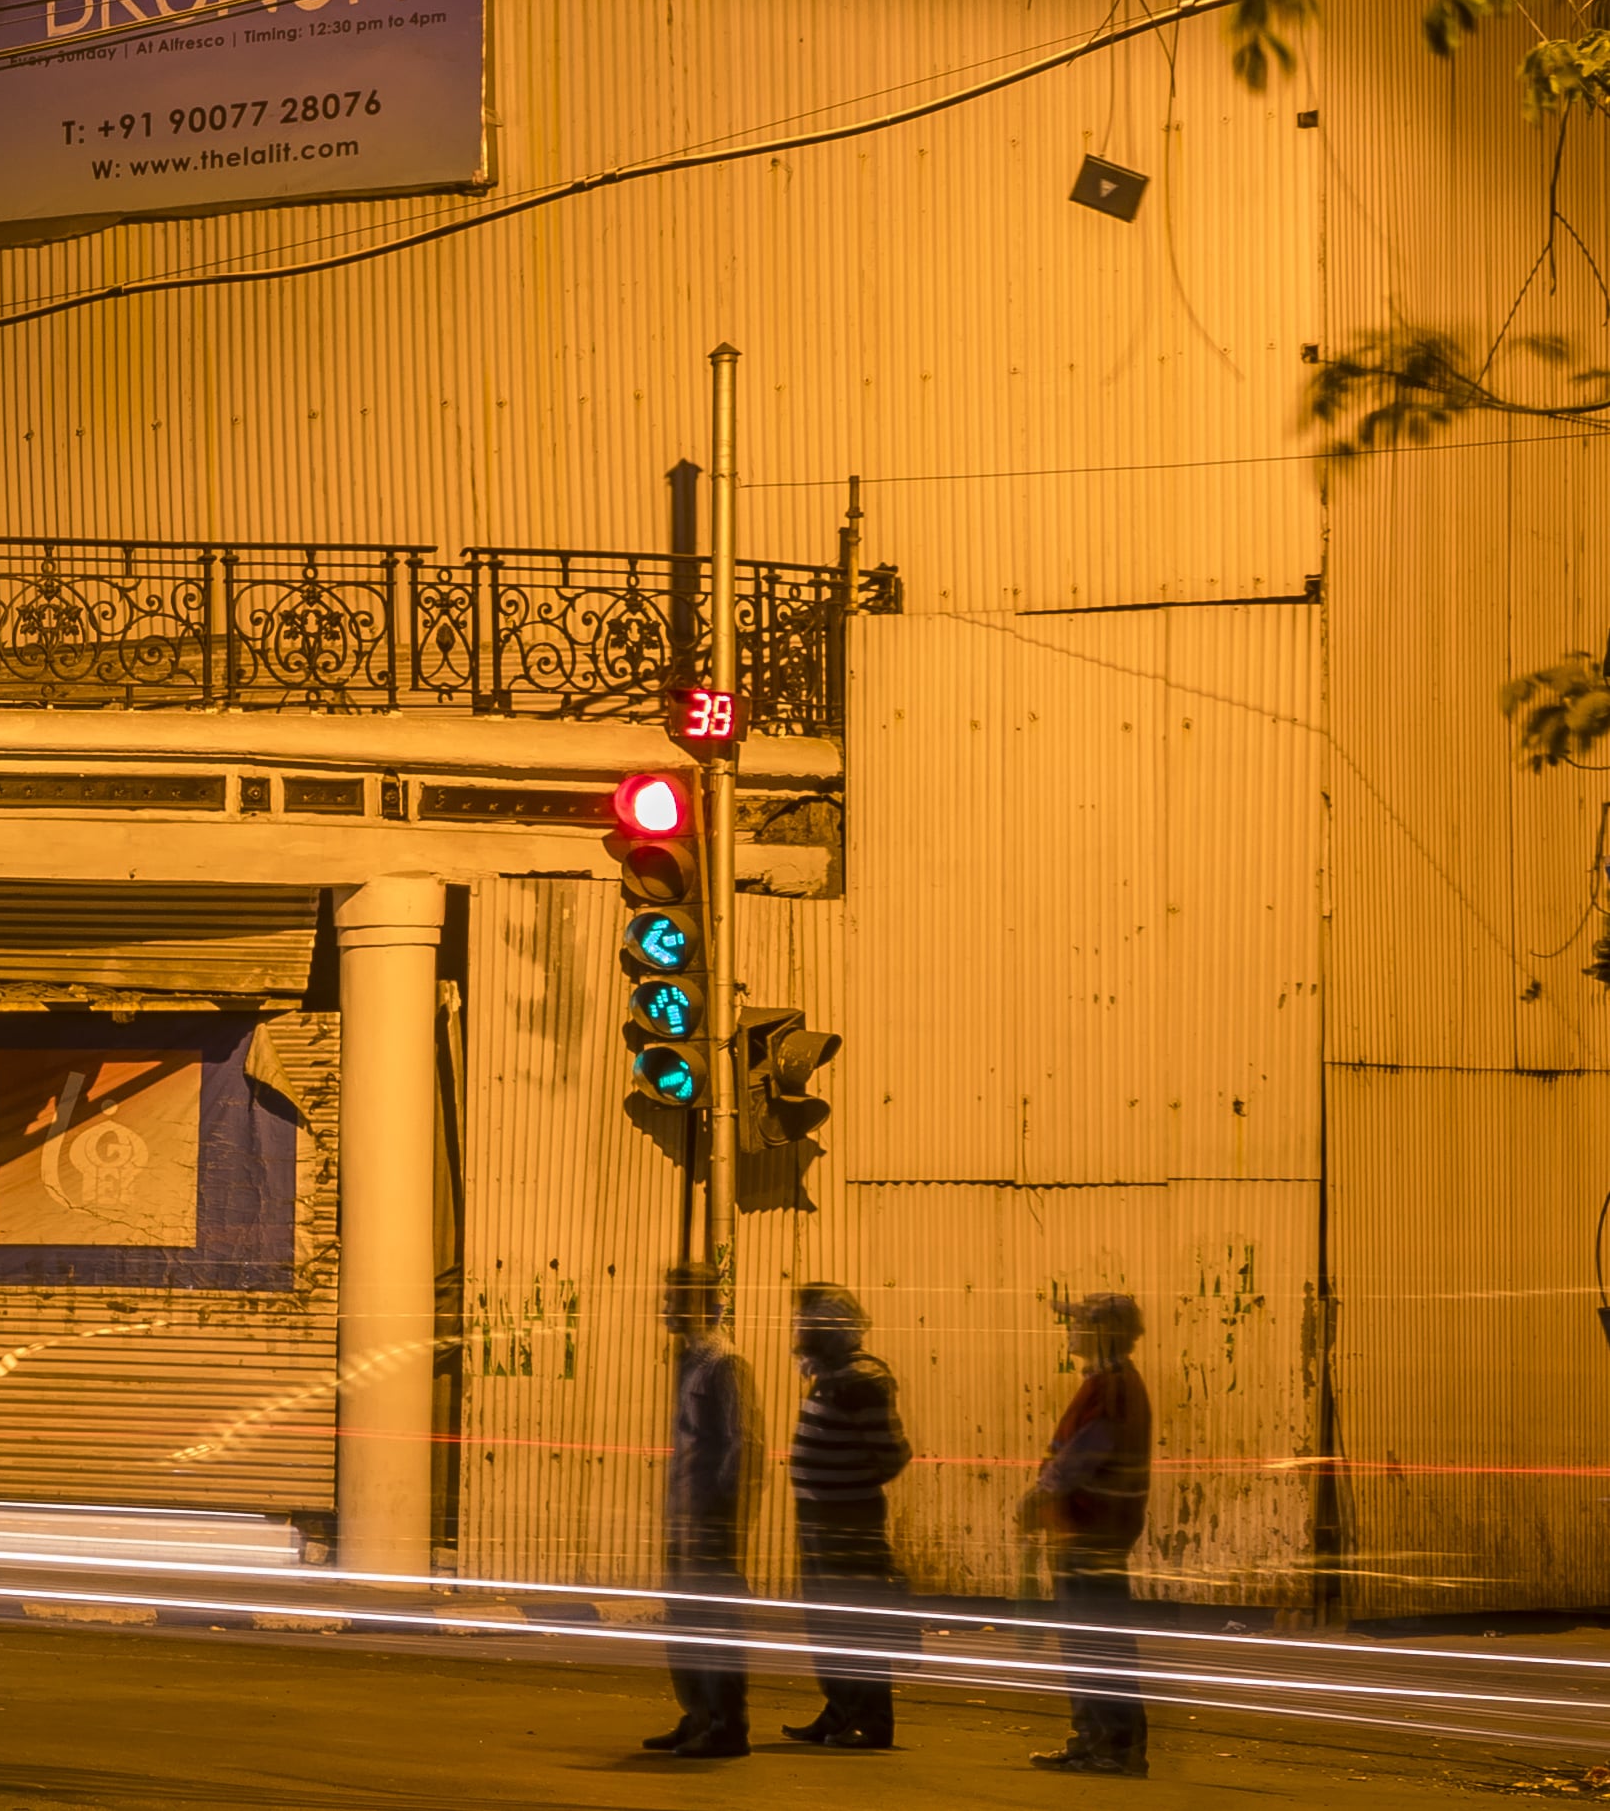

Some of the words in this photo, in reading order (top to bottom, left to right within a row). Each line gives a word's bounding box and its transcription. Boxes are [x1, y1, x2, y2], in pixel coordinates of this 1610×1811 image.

[135, 39, 158, 56] At
[160, 33, 225, 52] Alfresco
[243, 24, 303, 45] Timing:
[308, 20, 352, 38] 12:30
[356, 19, 384, 36] pm
[389, 13, 405, 29] to
[409, 11, 448, 30] 4pm
[61, 120, 86, 146] T:
[97, 112, 153, 140] +91
[168, 100, 270, 135] 90077
[279, 89, 383, 125] 28076
[91, 159, 122, 181] W:
[129, 138, 360, 178] www.thelalit.com
